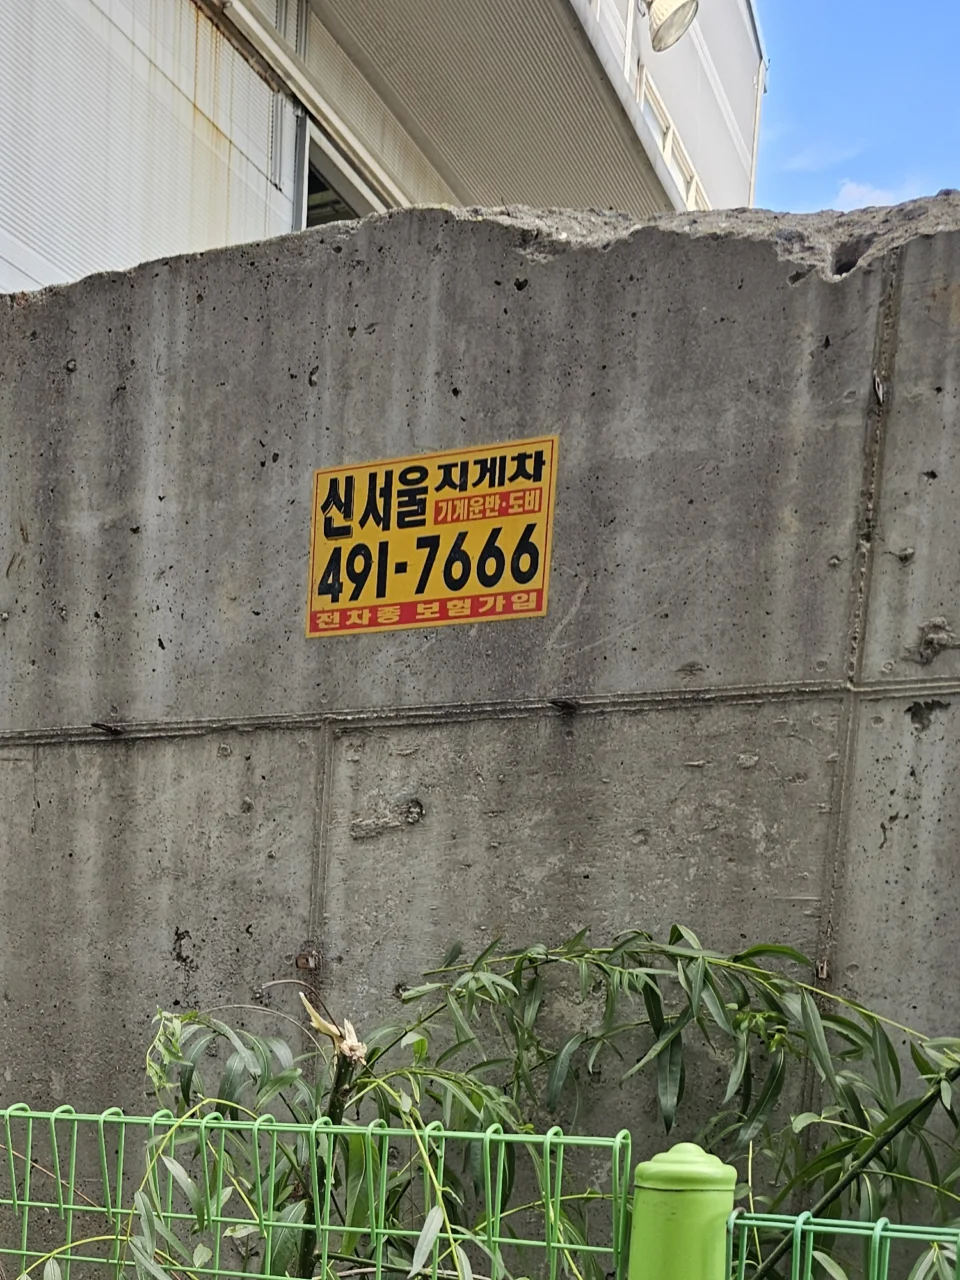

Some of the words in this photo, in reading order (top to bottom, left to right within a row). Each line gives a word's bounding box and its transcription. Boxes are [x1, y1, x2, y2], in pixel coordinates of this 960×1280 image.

[320, 465, 429, 540] 신서울
[434, 450, 546, 492] 지게차
[317, 523, 540, 603] 491-7666
[316, 605, 401, 628] 전차종
[415, 591, 538, 619] 보험가입
